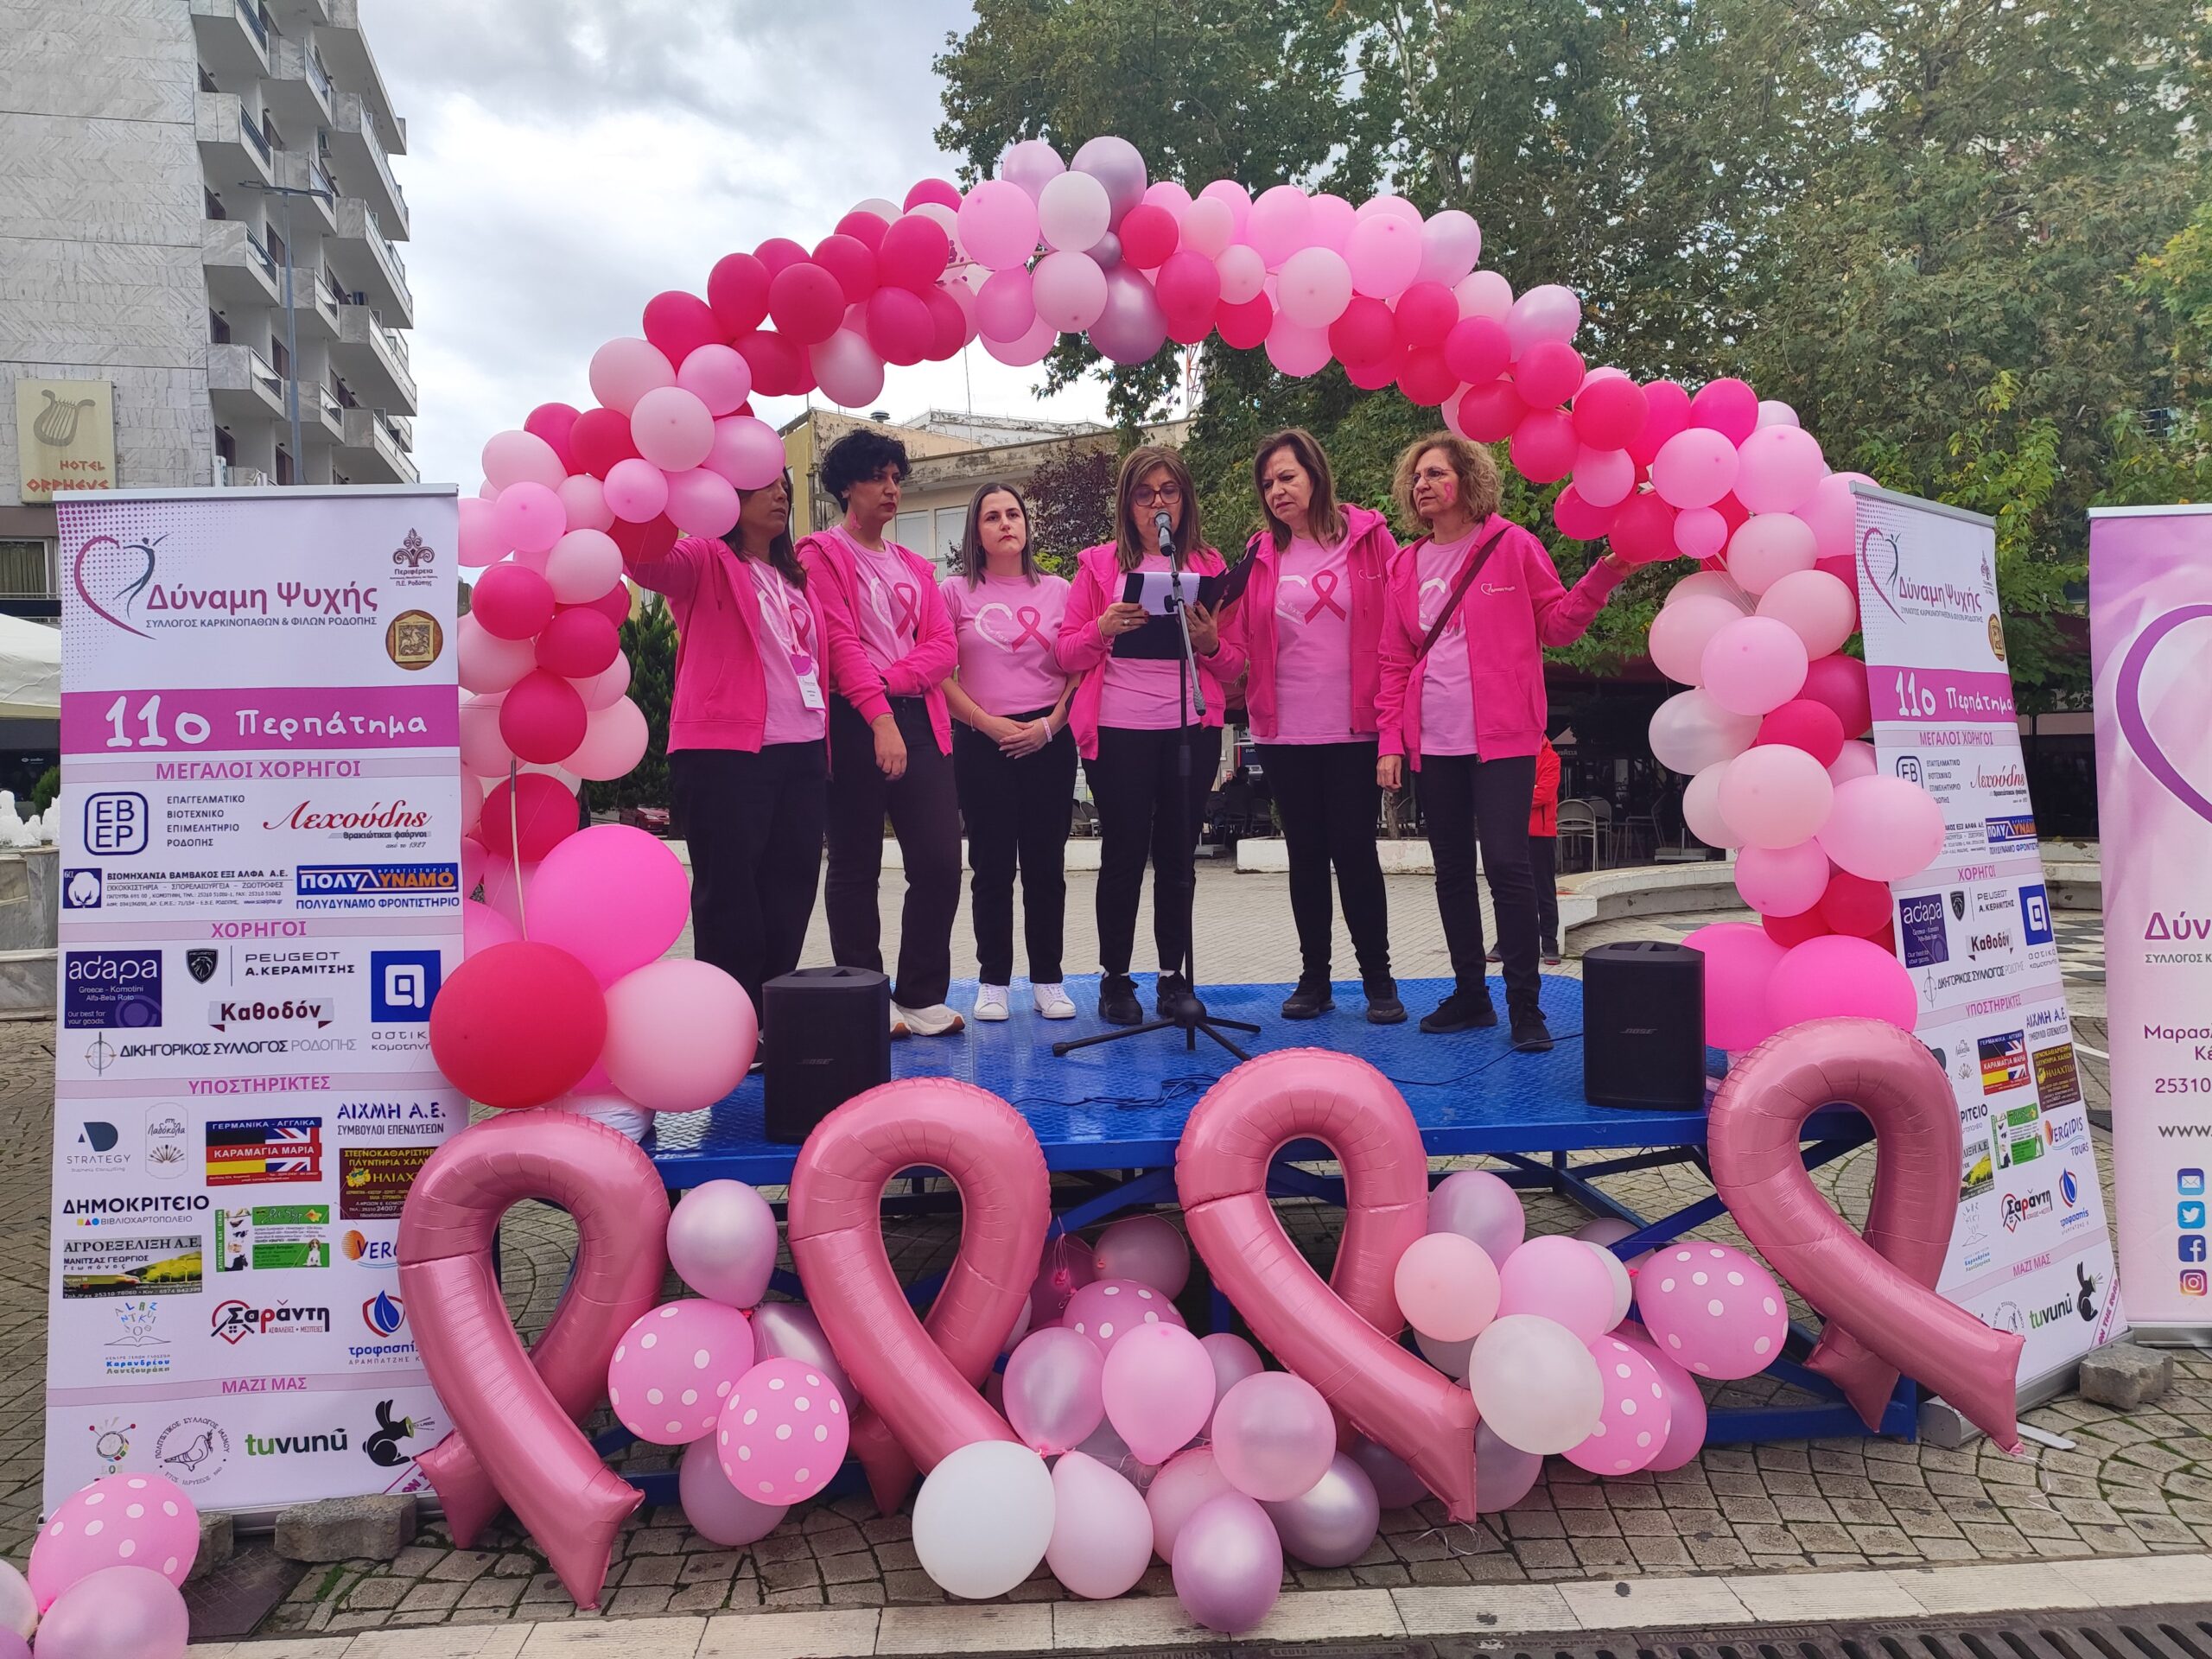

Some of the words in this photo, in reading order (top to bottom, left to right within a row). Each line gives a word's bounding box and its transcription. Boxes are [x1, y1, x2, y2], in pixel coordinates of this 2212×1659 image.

[60, 460, 105, 471] HOTEL
[146, 582, 267, 615] Δύναμη
[276, 581, 378, 614] Ψυχής
[1899, 576, 1947, 608] Δύναμη
[1944, 583, 1982, 613] Ψυχής
[146, 619, 198, 628] ΣΥΛΛΟΓΟΣ
[200, 617, 280, 627] ΚΑΡΚΙΝΟΠΑΘΩΝ
[282, 617, 289, 626] &
[290, 616, 326, 626] ΦΙΛΩΝ
[328, 616, 378, 625] ΡΟΔΟΠΗΣ
[1945, 687, 2013, 715] Περπάτημα
[235, 708, 428, 741] Περπάτημα
[1919, 731, 1961, 746] ΜΕΓΑΛΟΙ
[1961, 732, 1993, 746] ΧΟΡΗΓΟΙ
[156, 761, 253, 780] ΜΕΓΑΛΟΙ
[258, 760, 361, 779] ΧΟΡΗΓΟΙ
[167, 794, 245, 804] ΕΠΑΓΓΕΛΜΑΤΙΚΟ
[167, 810, 225, 819] ΒΙΟΤΕΧΝΙΚΟ
[263, 799, 433, 830] Λεχούδης
[167, 823, 239, 833] ΕΠΙΜΕΛΗΤΗΡΙΟ
[167, 838, 213, 847] ΡΟΔΟΠΗΣ
[107, 872, 167, 880] ΒΙΟΜΗΧΑΝΙΑ
[169, 871, 219, 880] ΒΑΜΒΑΚΟΣ
[1957, 865, 1996, 881] ΧΟΡΗΓΟΙ
[1977, 889, 2007, 900] PEUGEOT
[296, 898, 376, 909] ΠΟΛΥΔΥΝΑΜΟ
[378, 897, 460, 908] ΦΡΟΝΤΙΣΤΗΡΙΟ
[1904, 900, 1942, 925] adapa
[211, 921, 307, 938] ΧΟΡΗΓΟΙ
[2144, 911, 2211, 940] Δύν
[1971, 931, 2010, 952] Καθοδόν
[245, 951, 340, 963] PEUGEOT
[2145, 953, 2203, 963] ΣΥΛΛΟΓΟΣ
[68, 955, 158, 984] adapa
[245, 965, 355, 976] Α.ΚΕΡΑΜΙΤΣΗΣ
[1937, 970, 1971, 989] ΔΙΚΗΓΟΡΙΚΟΣ
[1972, 965, 2005, 982] ΣΥΛΛΟΓΟΣ
[220, 1000, 321, 1021] Καθοδόν
[1966, 994, 2022, 1017] ΥΠΟΣΤΗΡΙΚΤΕΣ
[2026, 1009, 2052, 1028] ΑΙΧΜΗ
[2054, 1007, 2067, 1023] Α.Ε.
[2144, 1025, 2212, 1043] Μαρασ
[119, 1043, 212, 1058] ΔΙΚΗΓΟΡΙΚΟΣ
[213, 1039, 288, 1055] ΣΥΛΛΟΓΟΣ
[291, 1039, 357, 1052] ΡΟΔΟΠΗΣ
[1983, 1058, 2012, 1071] ΚΑΡΑΜΑΓΙΑ
[188, 1076, 331, 1095] ΥΠΟΣΤΗΡΙΚΤΕΣ
[2155, 1077, 2211, 1093] 25310
[337, 1103, 401, 1119] ΑΙΧΜΗ
[409, 1102, 446, 1119] Α.Ε.
[337, 1125, 385, 1135] ΣΥΜΒΟΥΛΟΙ
[387, 1123, 444, 1135] ΕΠΕΝΔΥΣΕΩΝ
[2050, 1117, 2083, 1142] VERGIDIS
[213, 1147, 279, 1158] ΚΑΡΑΜΑΓΙΑ
[281, 1146, 315, 1154] ΜΑΡΙΑ
[345, 1148, 435, 1157] ΣΤΕΓΝΟΚΑΘΑΡΙΣΤΗΡ
[2070, 1142, 2089, 1157] TOURS
[66, 1154, 131, 1164] STRATEGY
[63, 1195, 209, 1214] ΔΗΜΟΚΡΙΤΕΙΟ
[2006, 1190, 2053, 1220] Σαράντη
[100, 1215, 192, 1225] ΒΙΒΛΙΟΧΑΡΤΟΠΩΛΕΙΟ
[64, 1239, 170, 1253] ΑΓΡΟΕΞΕΛΙΞΗ
[173, 1237, 201, 1249] Α.Ε.
[2013, 1260, 2032, 1277] ΜΑΖΙ
[2033, 1254, 2051, 1269] ΜΑΣ
[227, 1306, 330, 1333] Σαράντη
[2102, 1306, 2113, 1330] THE
[348, 1341, 418, 1357] τροφασπί
[348, 1357, 410, 1365] ΑΡΑΜΠΑΤΖΗΣ
[222, 1378, 266, 1393] ΜΑΖΙ
[271, 1377, 307, 1390] ΜΑΣ
